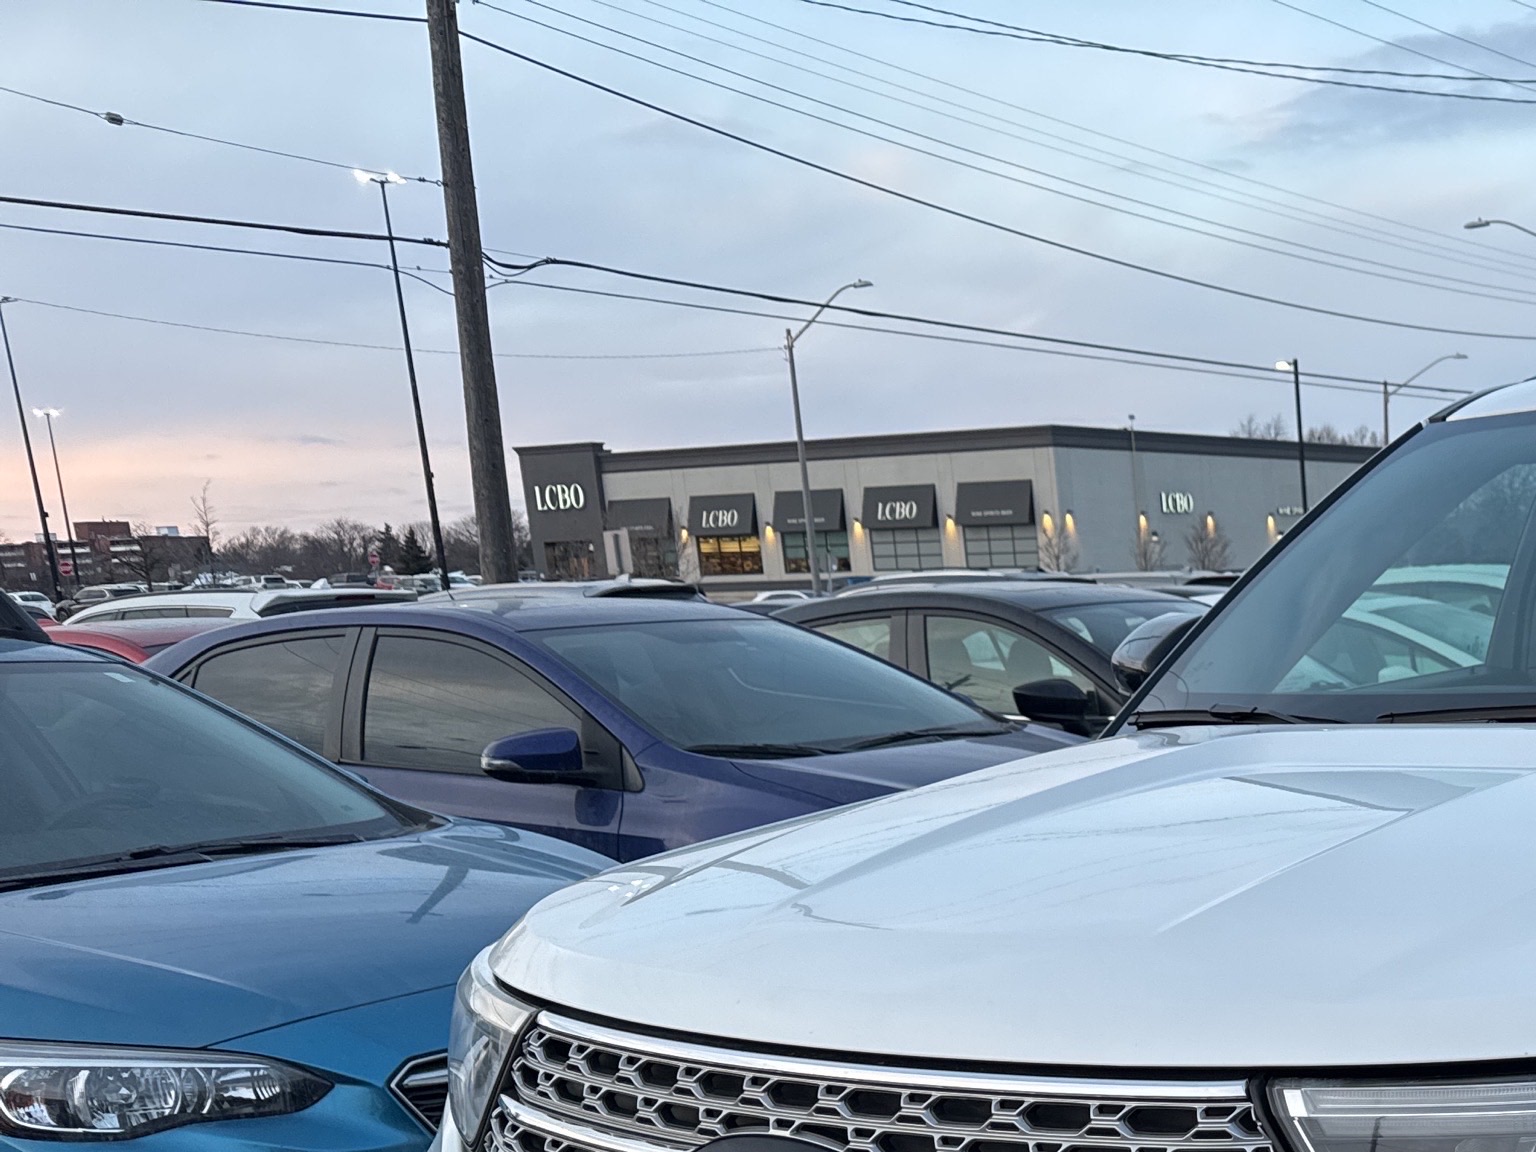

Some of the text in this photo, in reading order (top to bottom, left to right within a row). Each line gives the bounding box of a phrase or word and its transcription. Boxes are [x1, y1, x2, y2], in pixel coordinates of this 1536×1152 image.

[534, 483, 584, 511] LCBO
[1161, 491, 1194, 513] LCBO
[702, 509, 738, 529] LCBO
[877, 500, 917, 521] LCBO
